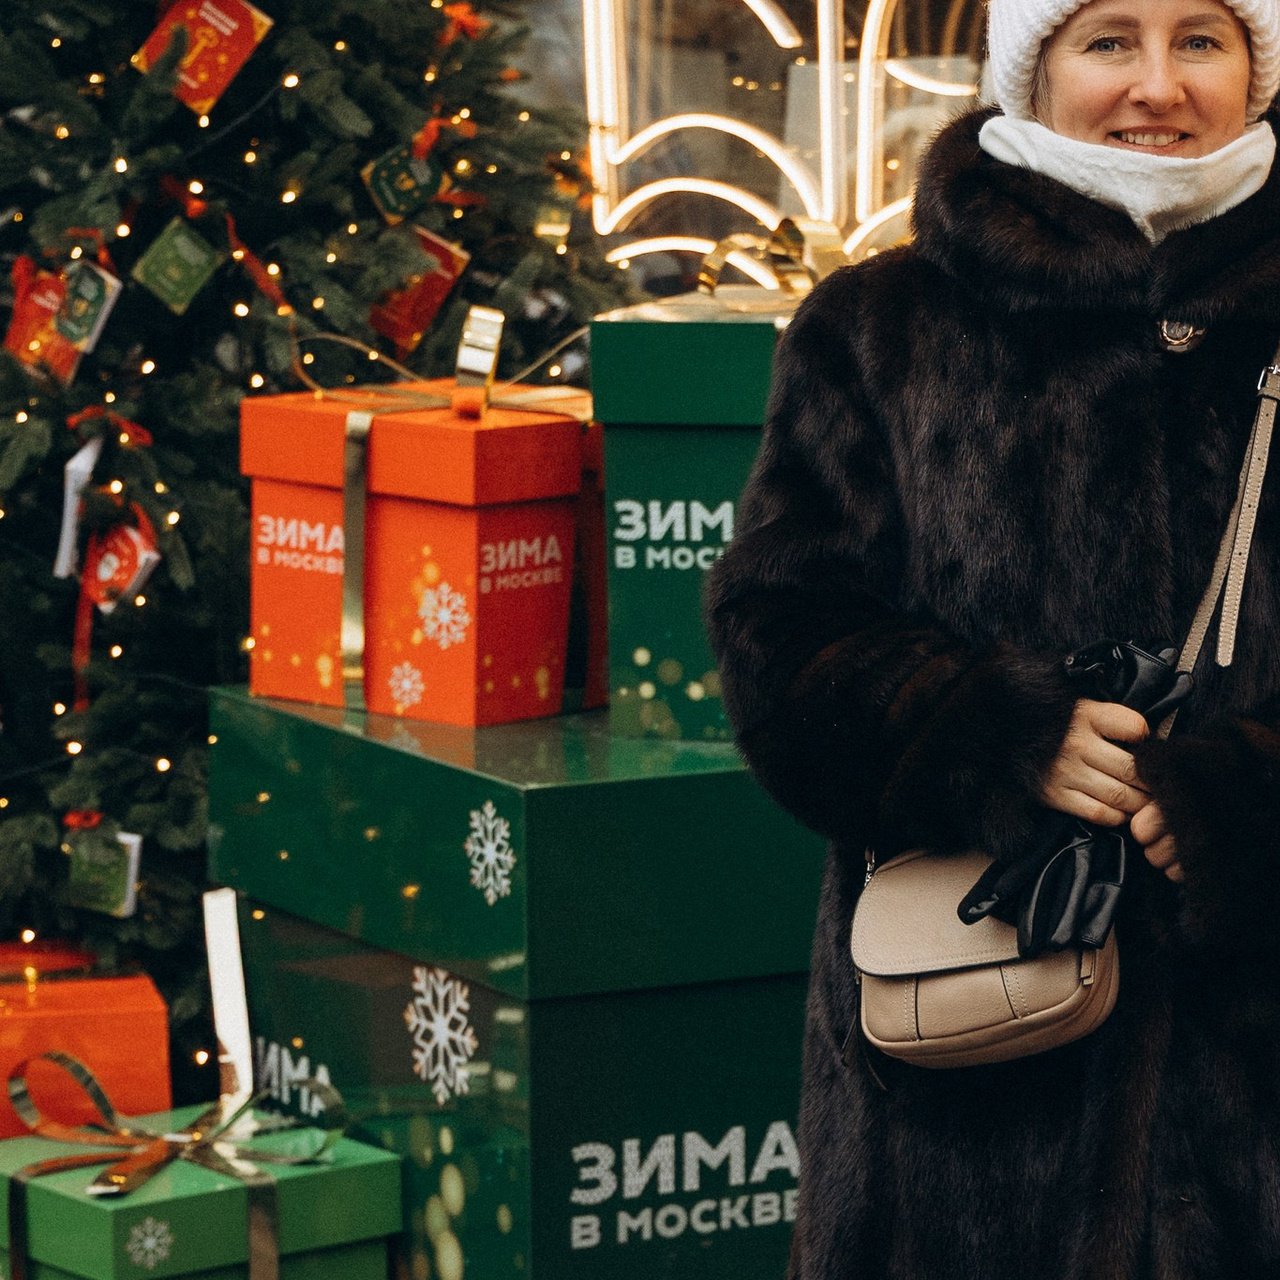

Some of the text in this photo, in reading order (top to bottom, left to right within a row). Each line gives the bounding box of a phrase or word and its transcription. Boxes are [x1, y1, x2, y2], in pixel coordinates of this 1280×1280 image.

[257, 514, 344, 554] ЗИМА
[613, 499, 735, 542] ЗИМ
[256, 546, 270, 565] В
[480, 535, 563, 573] ЗИМА
[615, 545, 724, 570] В МОС
[479, 567, 563, 594] В МОСКВЕ
[256, 1036, 331, 1118] ИМА
[569, 1120, 800, 1206] ЗИМА
[570, 1188, 800, 1251] В МОСКВЕ
